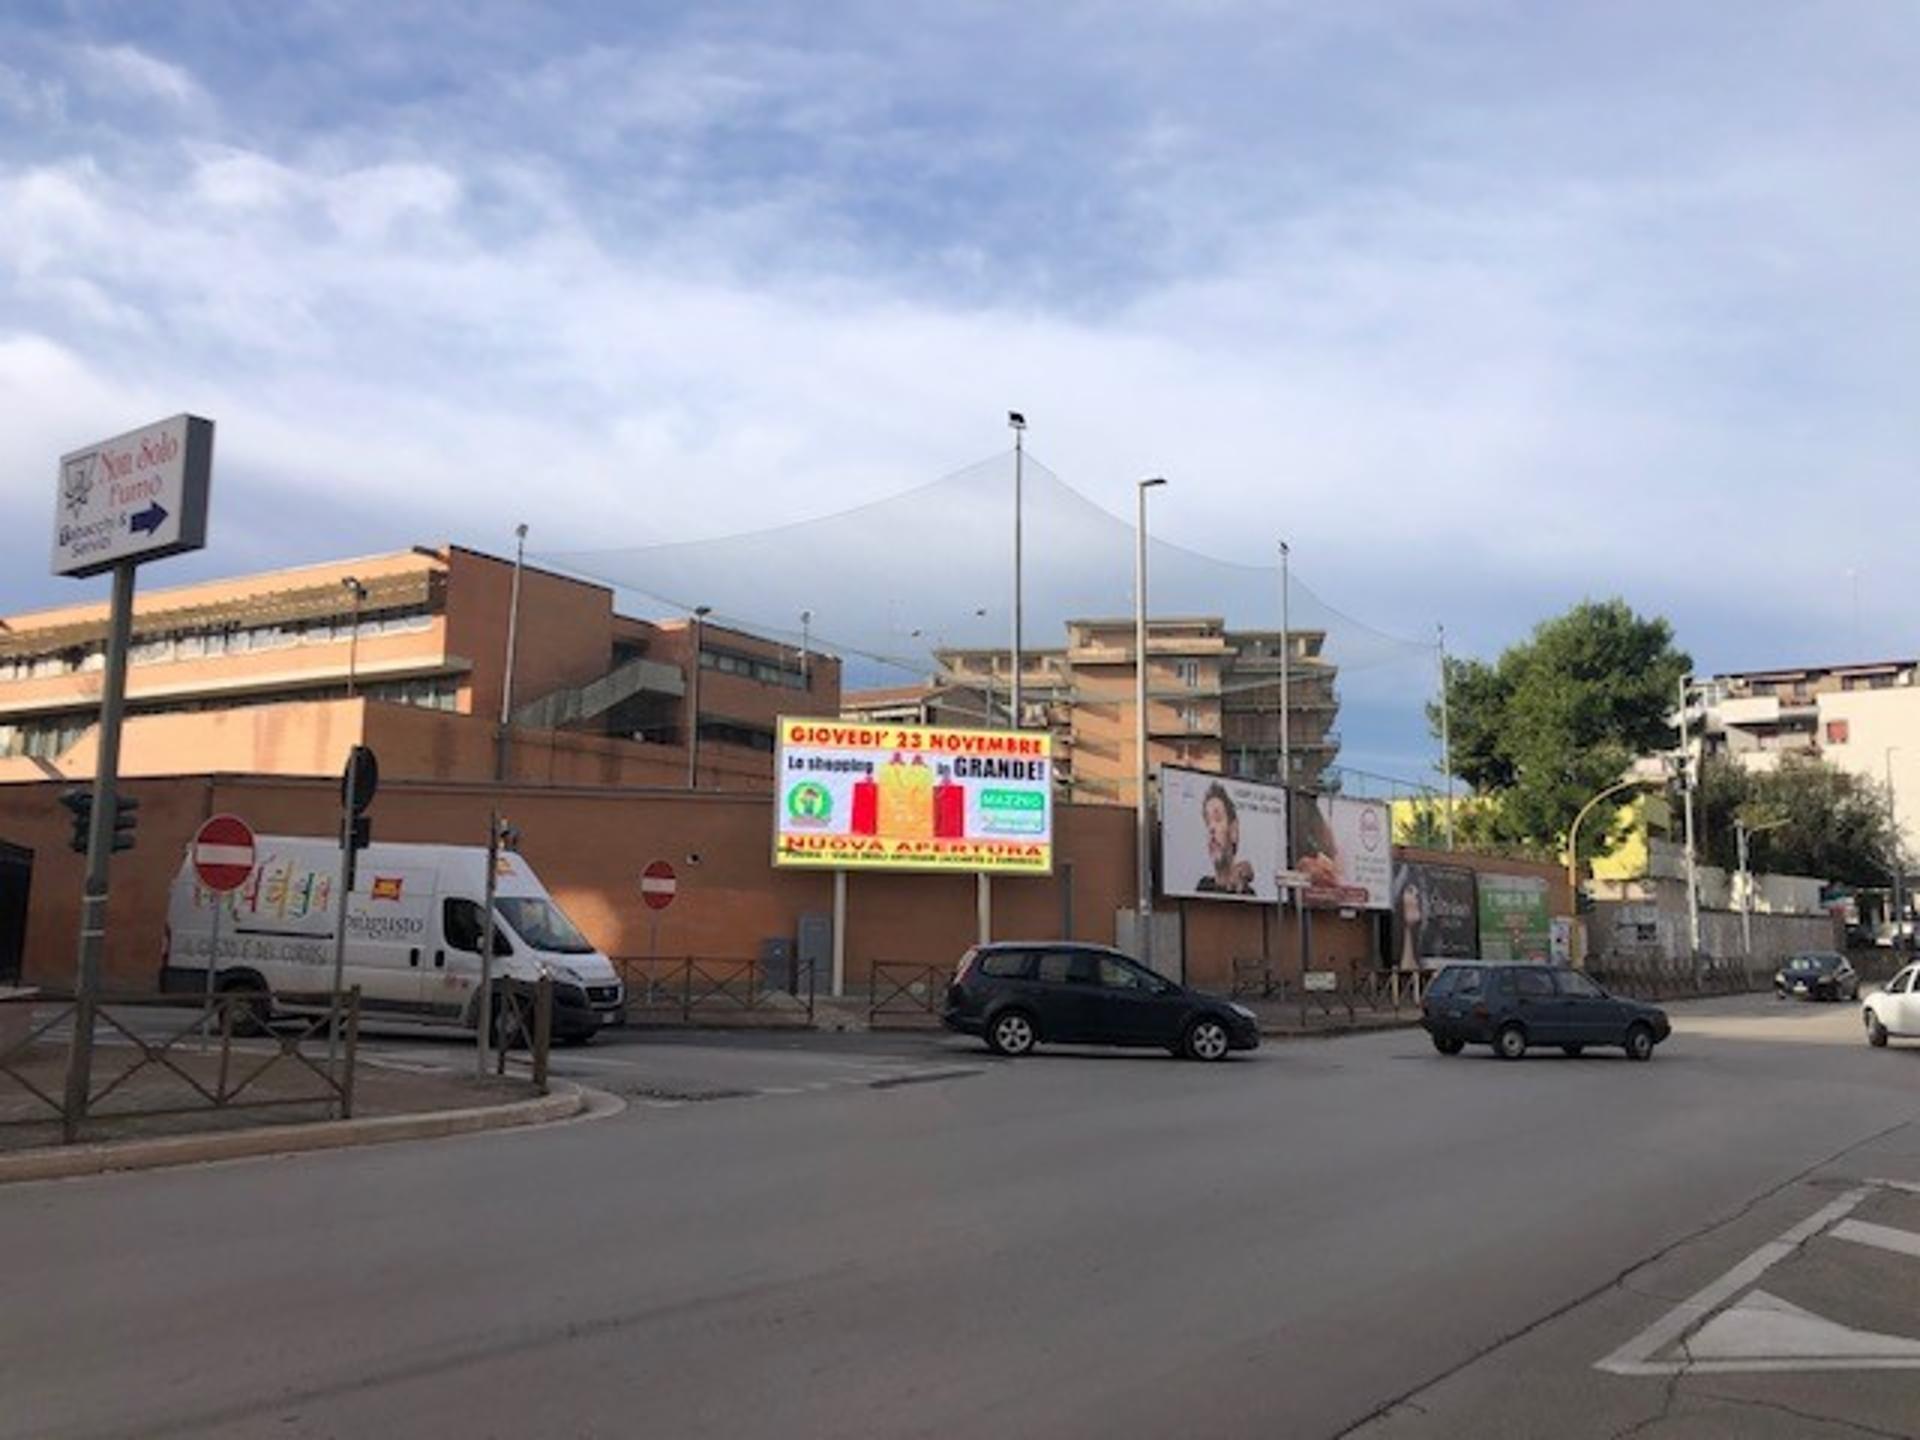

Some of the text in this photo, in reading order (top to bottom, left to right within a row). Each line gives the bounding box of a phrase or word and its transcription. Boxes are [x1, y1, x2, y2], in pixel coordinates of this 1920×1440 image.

[102, 432, 178, 482] Non Solo
[896, 731, 923, 748] 23
[929, 733, 1042, 754] NOVEMBRE
[808, 756, 875, 775] shopping
[954, 757, 1044, 781] GRANDE!
[786, 836, 1042, 856] NUOVA APERTURA
